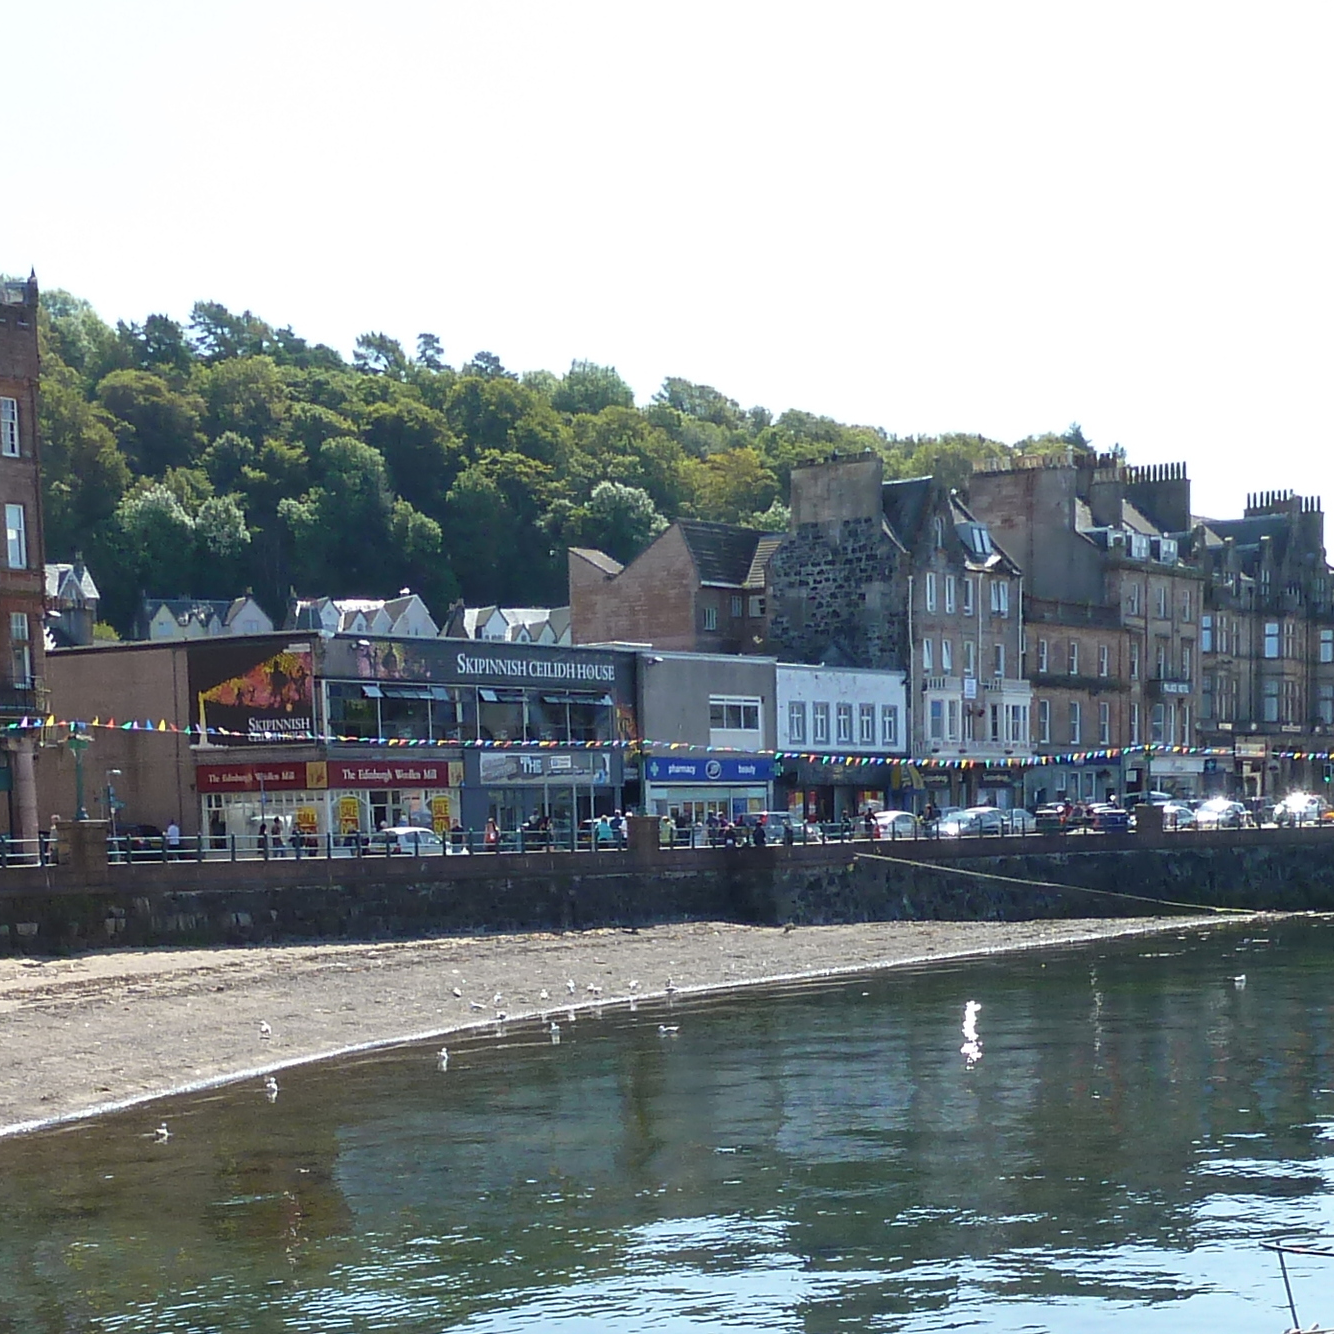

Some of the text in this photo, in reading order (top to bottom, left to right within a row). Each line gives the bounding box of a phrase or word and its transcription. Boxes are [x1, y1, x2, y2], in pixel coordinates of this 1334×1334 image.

[457, 653, 615, 681] SKIPINNISH CEILIDH HOUSE
[248, 717, 310, 732] SKIPINNISH
[342, 769, 356, 780] The
[358, 768, 393, 783] Edinburgh
